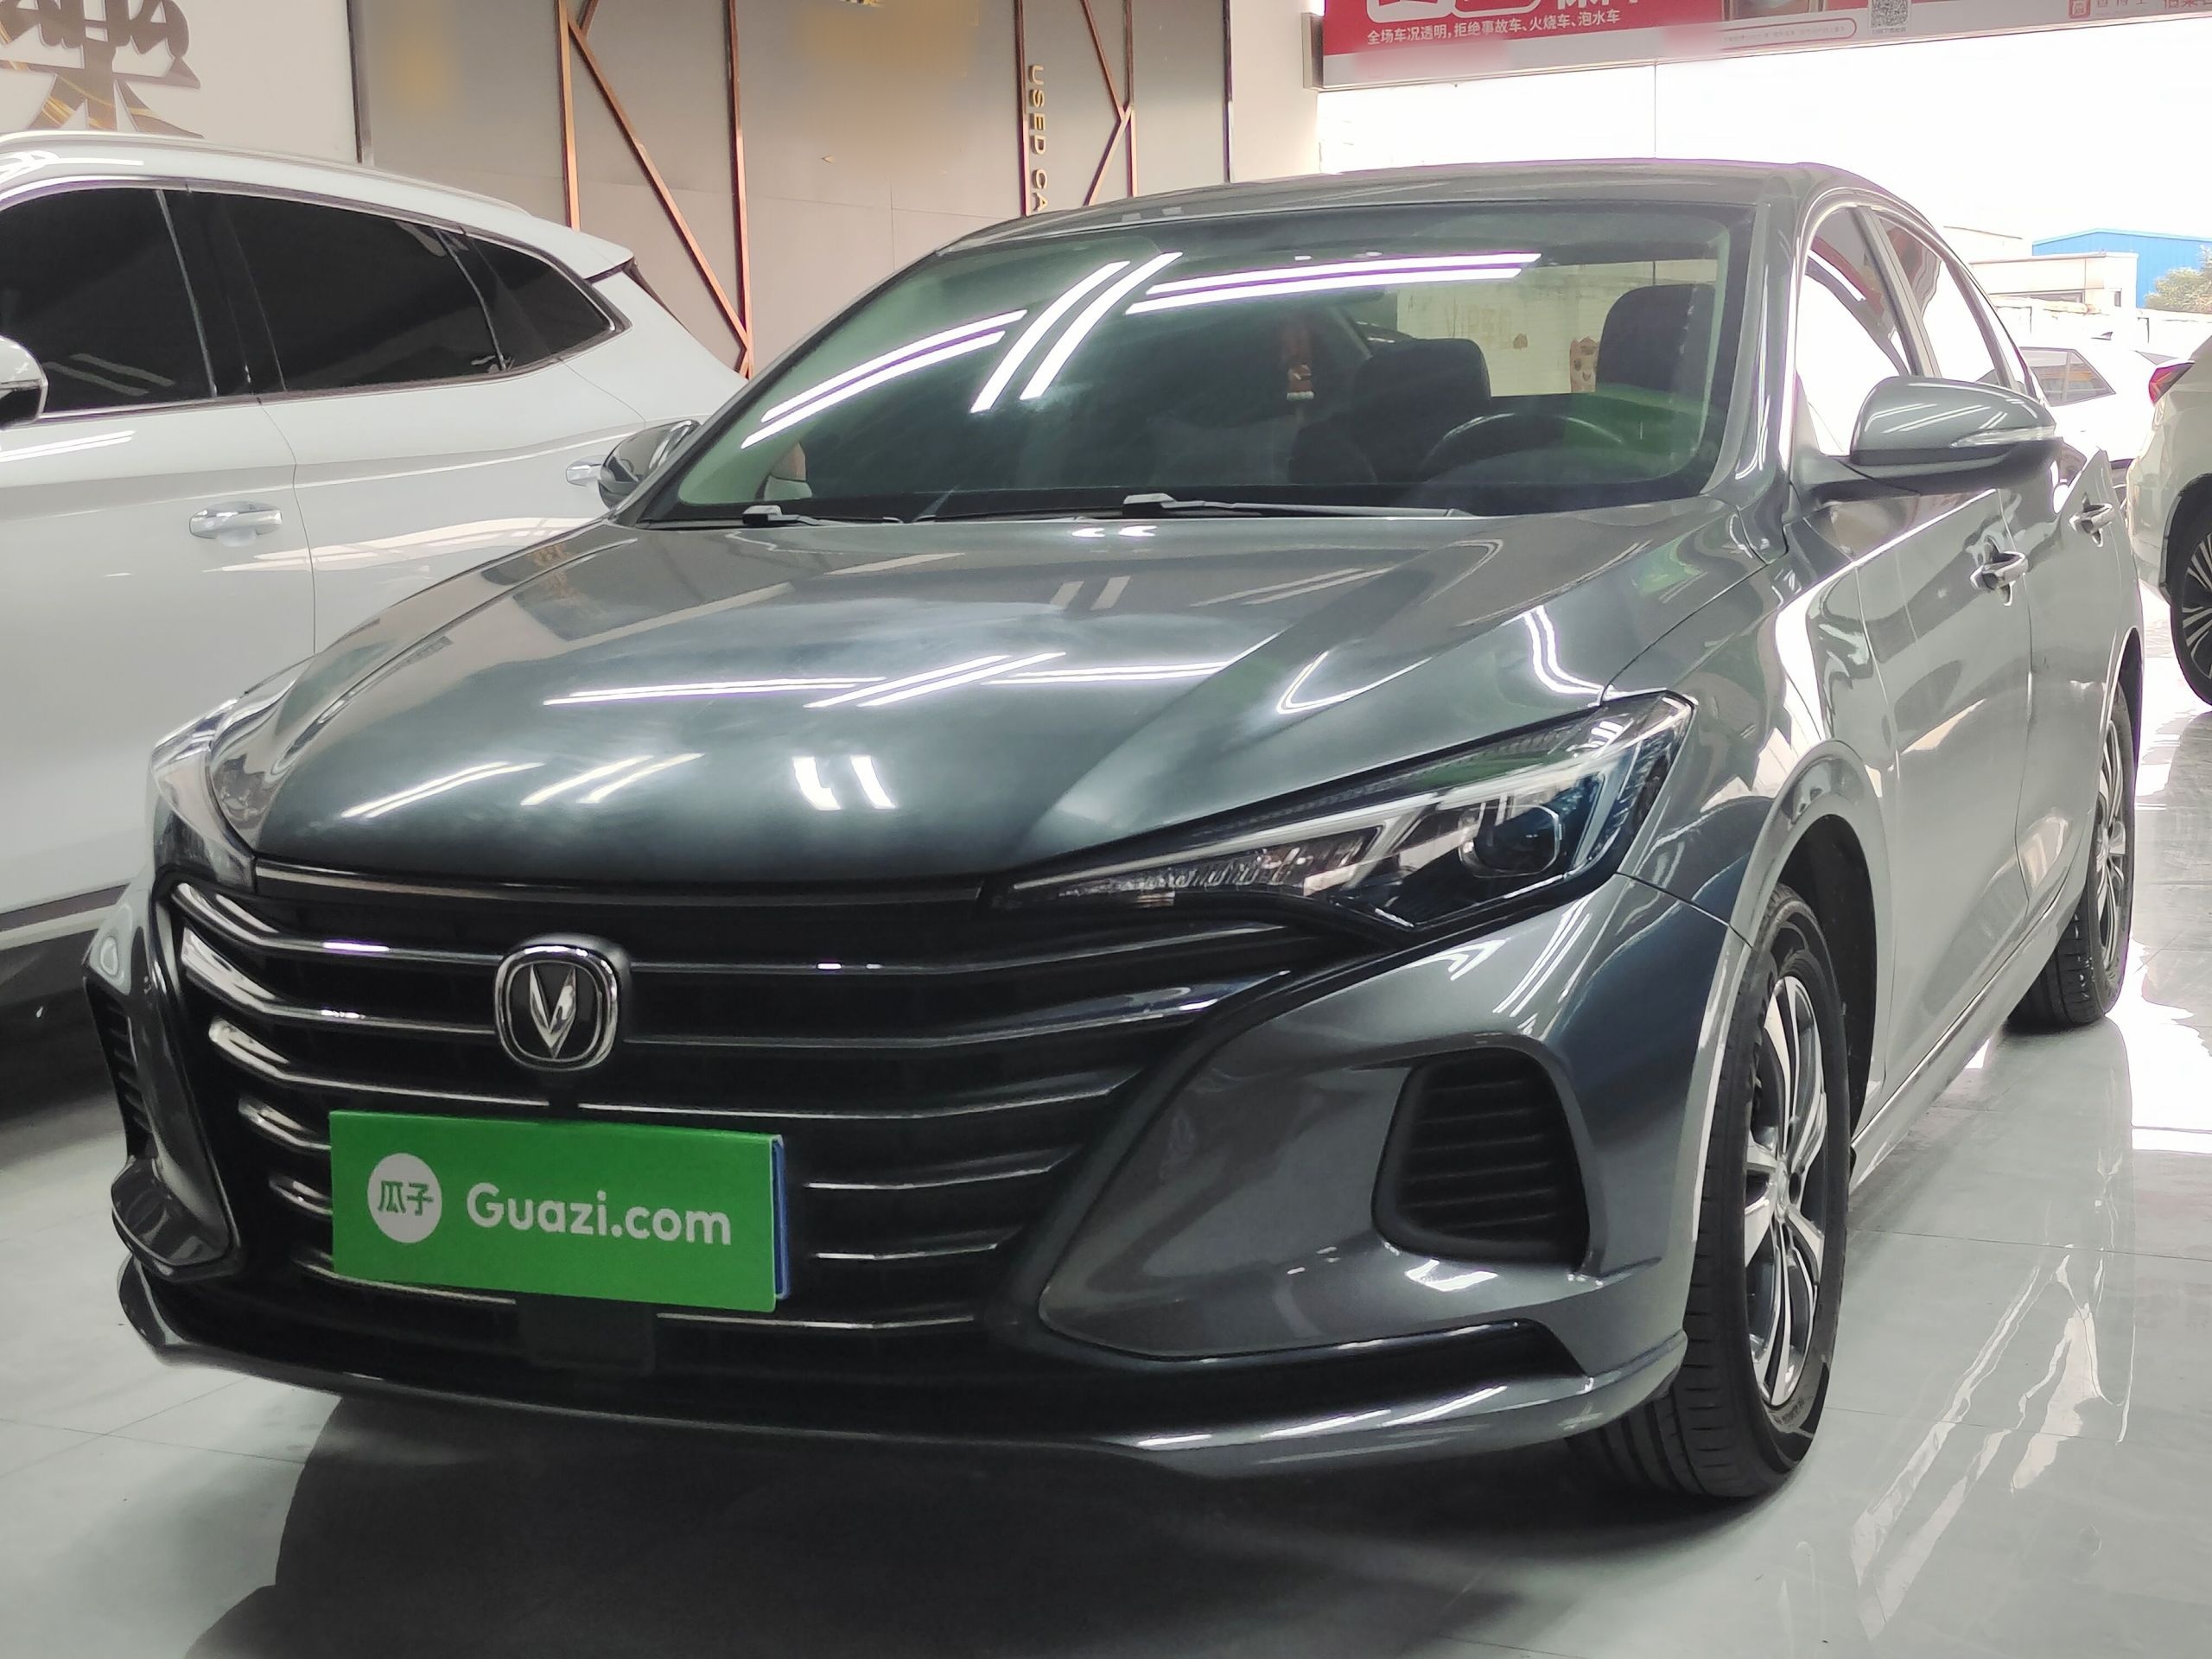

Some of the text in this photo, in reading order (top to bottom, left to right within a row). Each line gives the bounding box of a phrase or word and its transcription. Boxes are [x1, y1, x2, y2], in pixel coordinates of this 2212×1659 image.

[1030, 65, 1046, 156] USED
[378, 1179, 435, 1217] 瓜子
[466, 1182, 732, 1246] Guazi.com
